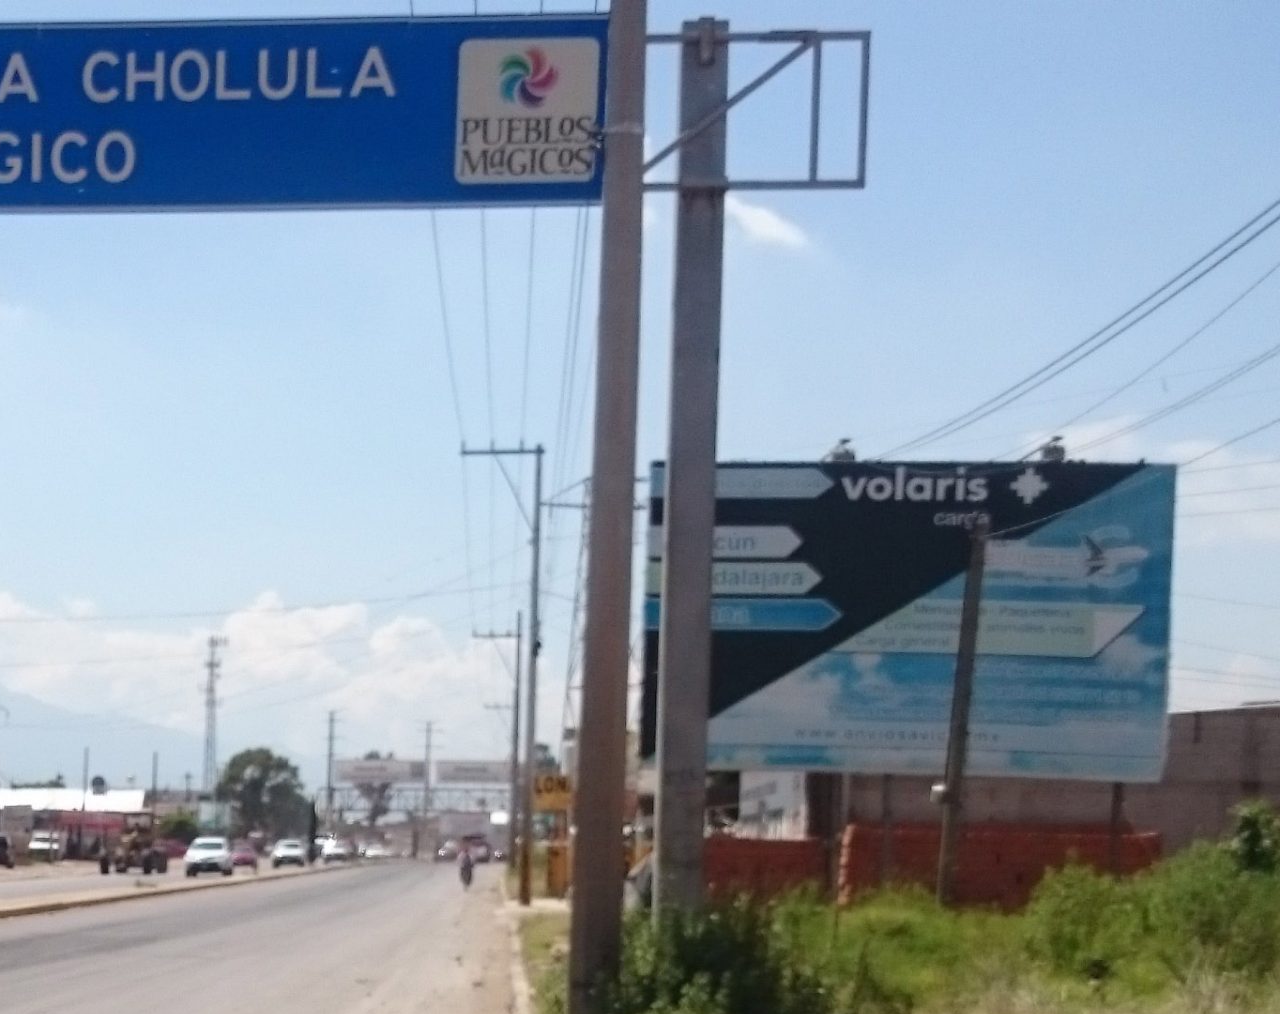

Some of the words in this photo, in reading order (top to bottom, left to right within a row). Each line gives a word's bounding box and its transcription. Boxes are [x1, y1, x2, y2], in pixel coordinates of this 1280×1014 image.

[82, 46, 396, 103] CHOLULA
[841, 465, 990, 502] volaris
[713, 568, 804, 589] dalajara
